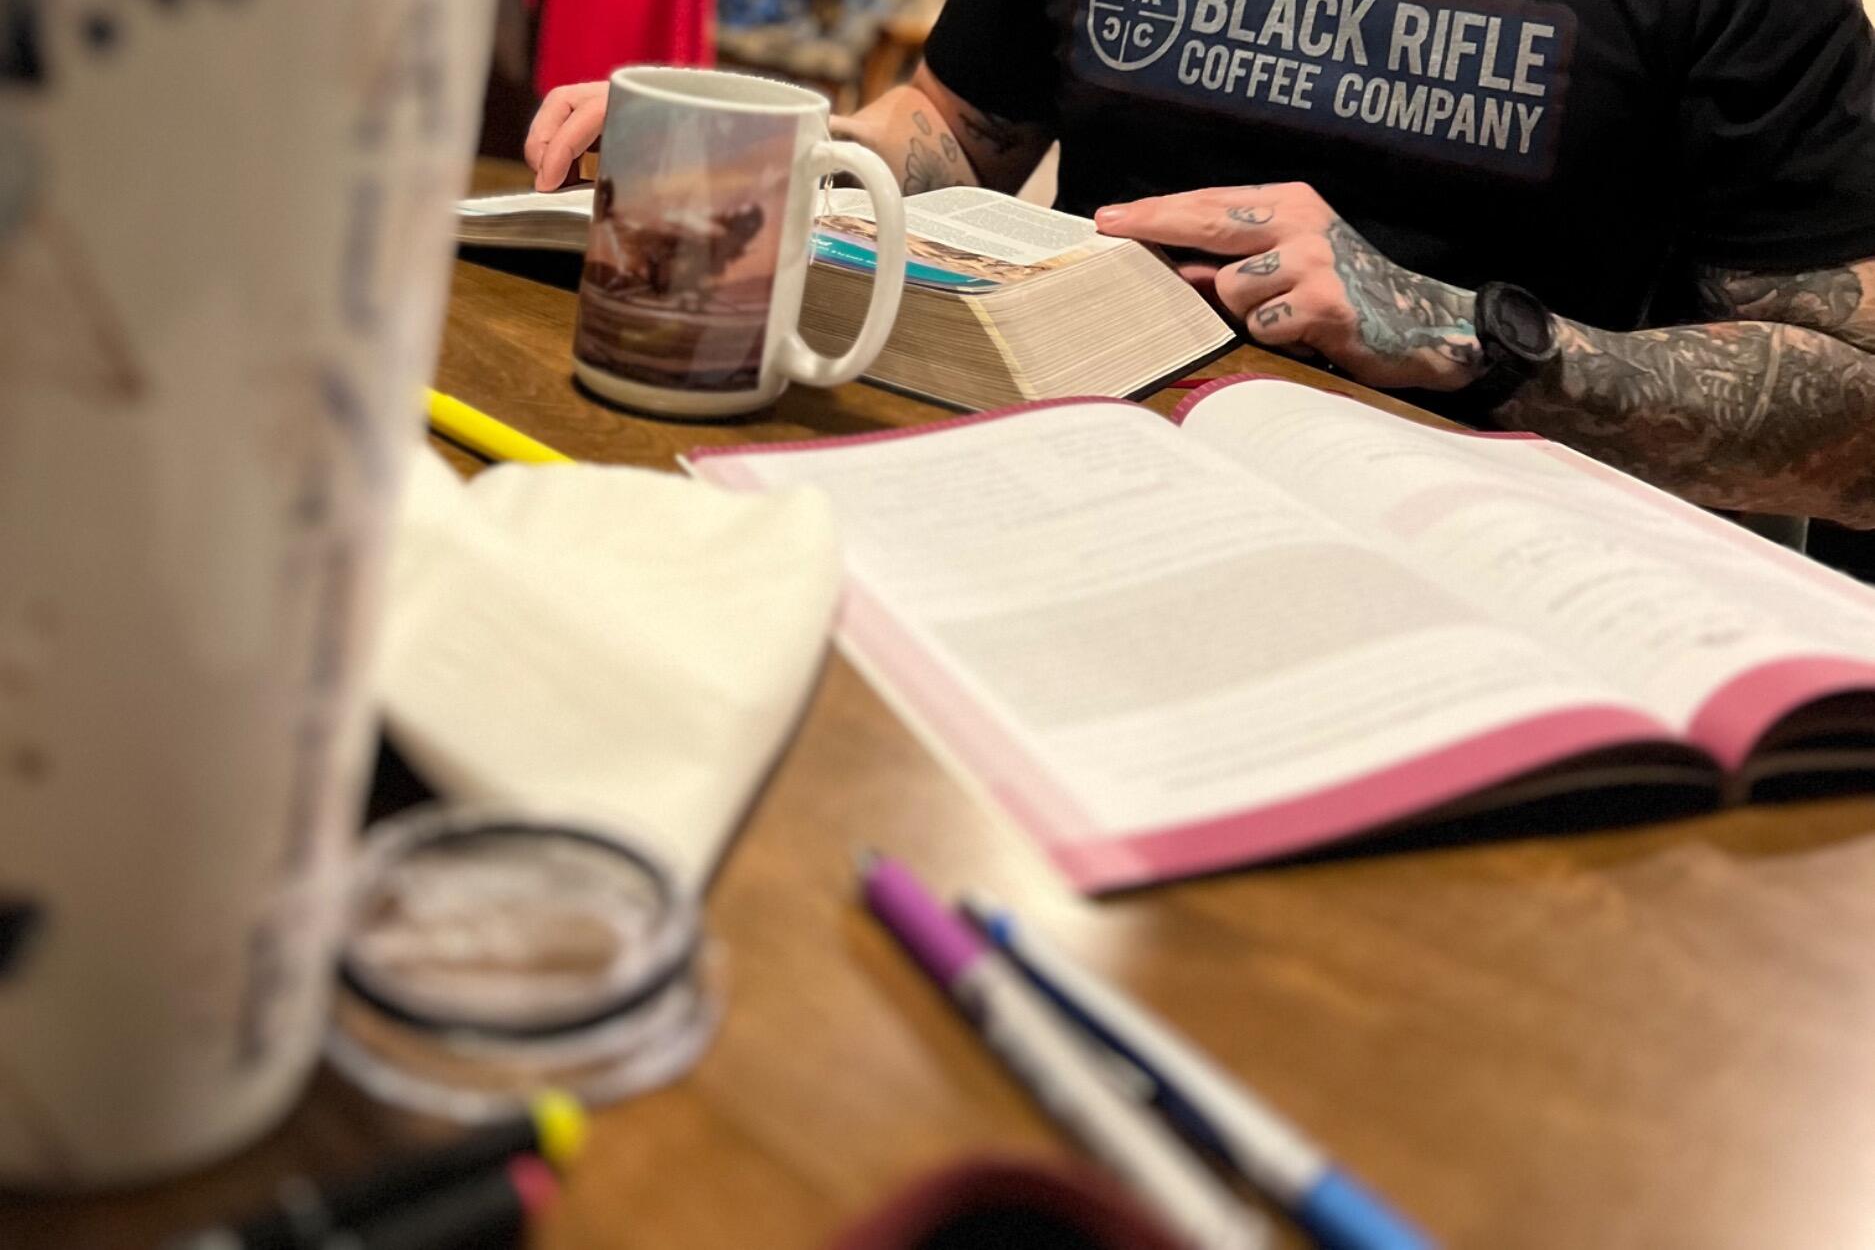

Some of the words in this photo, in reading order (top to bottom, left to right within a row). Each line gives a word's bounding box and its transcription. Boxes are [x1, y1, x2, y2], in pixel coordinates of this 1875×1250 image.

[1132, 22, 1155, 48] C
[1387, 2, 1555, 97] RIFLE
[1178, 39, 1322, 110] COFFEE
[1333, 72, 1544, 154] COMPANY
